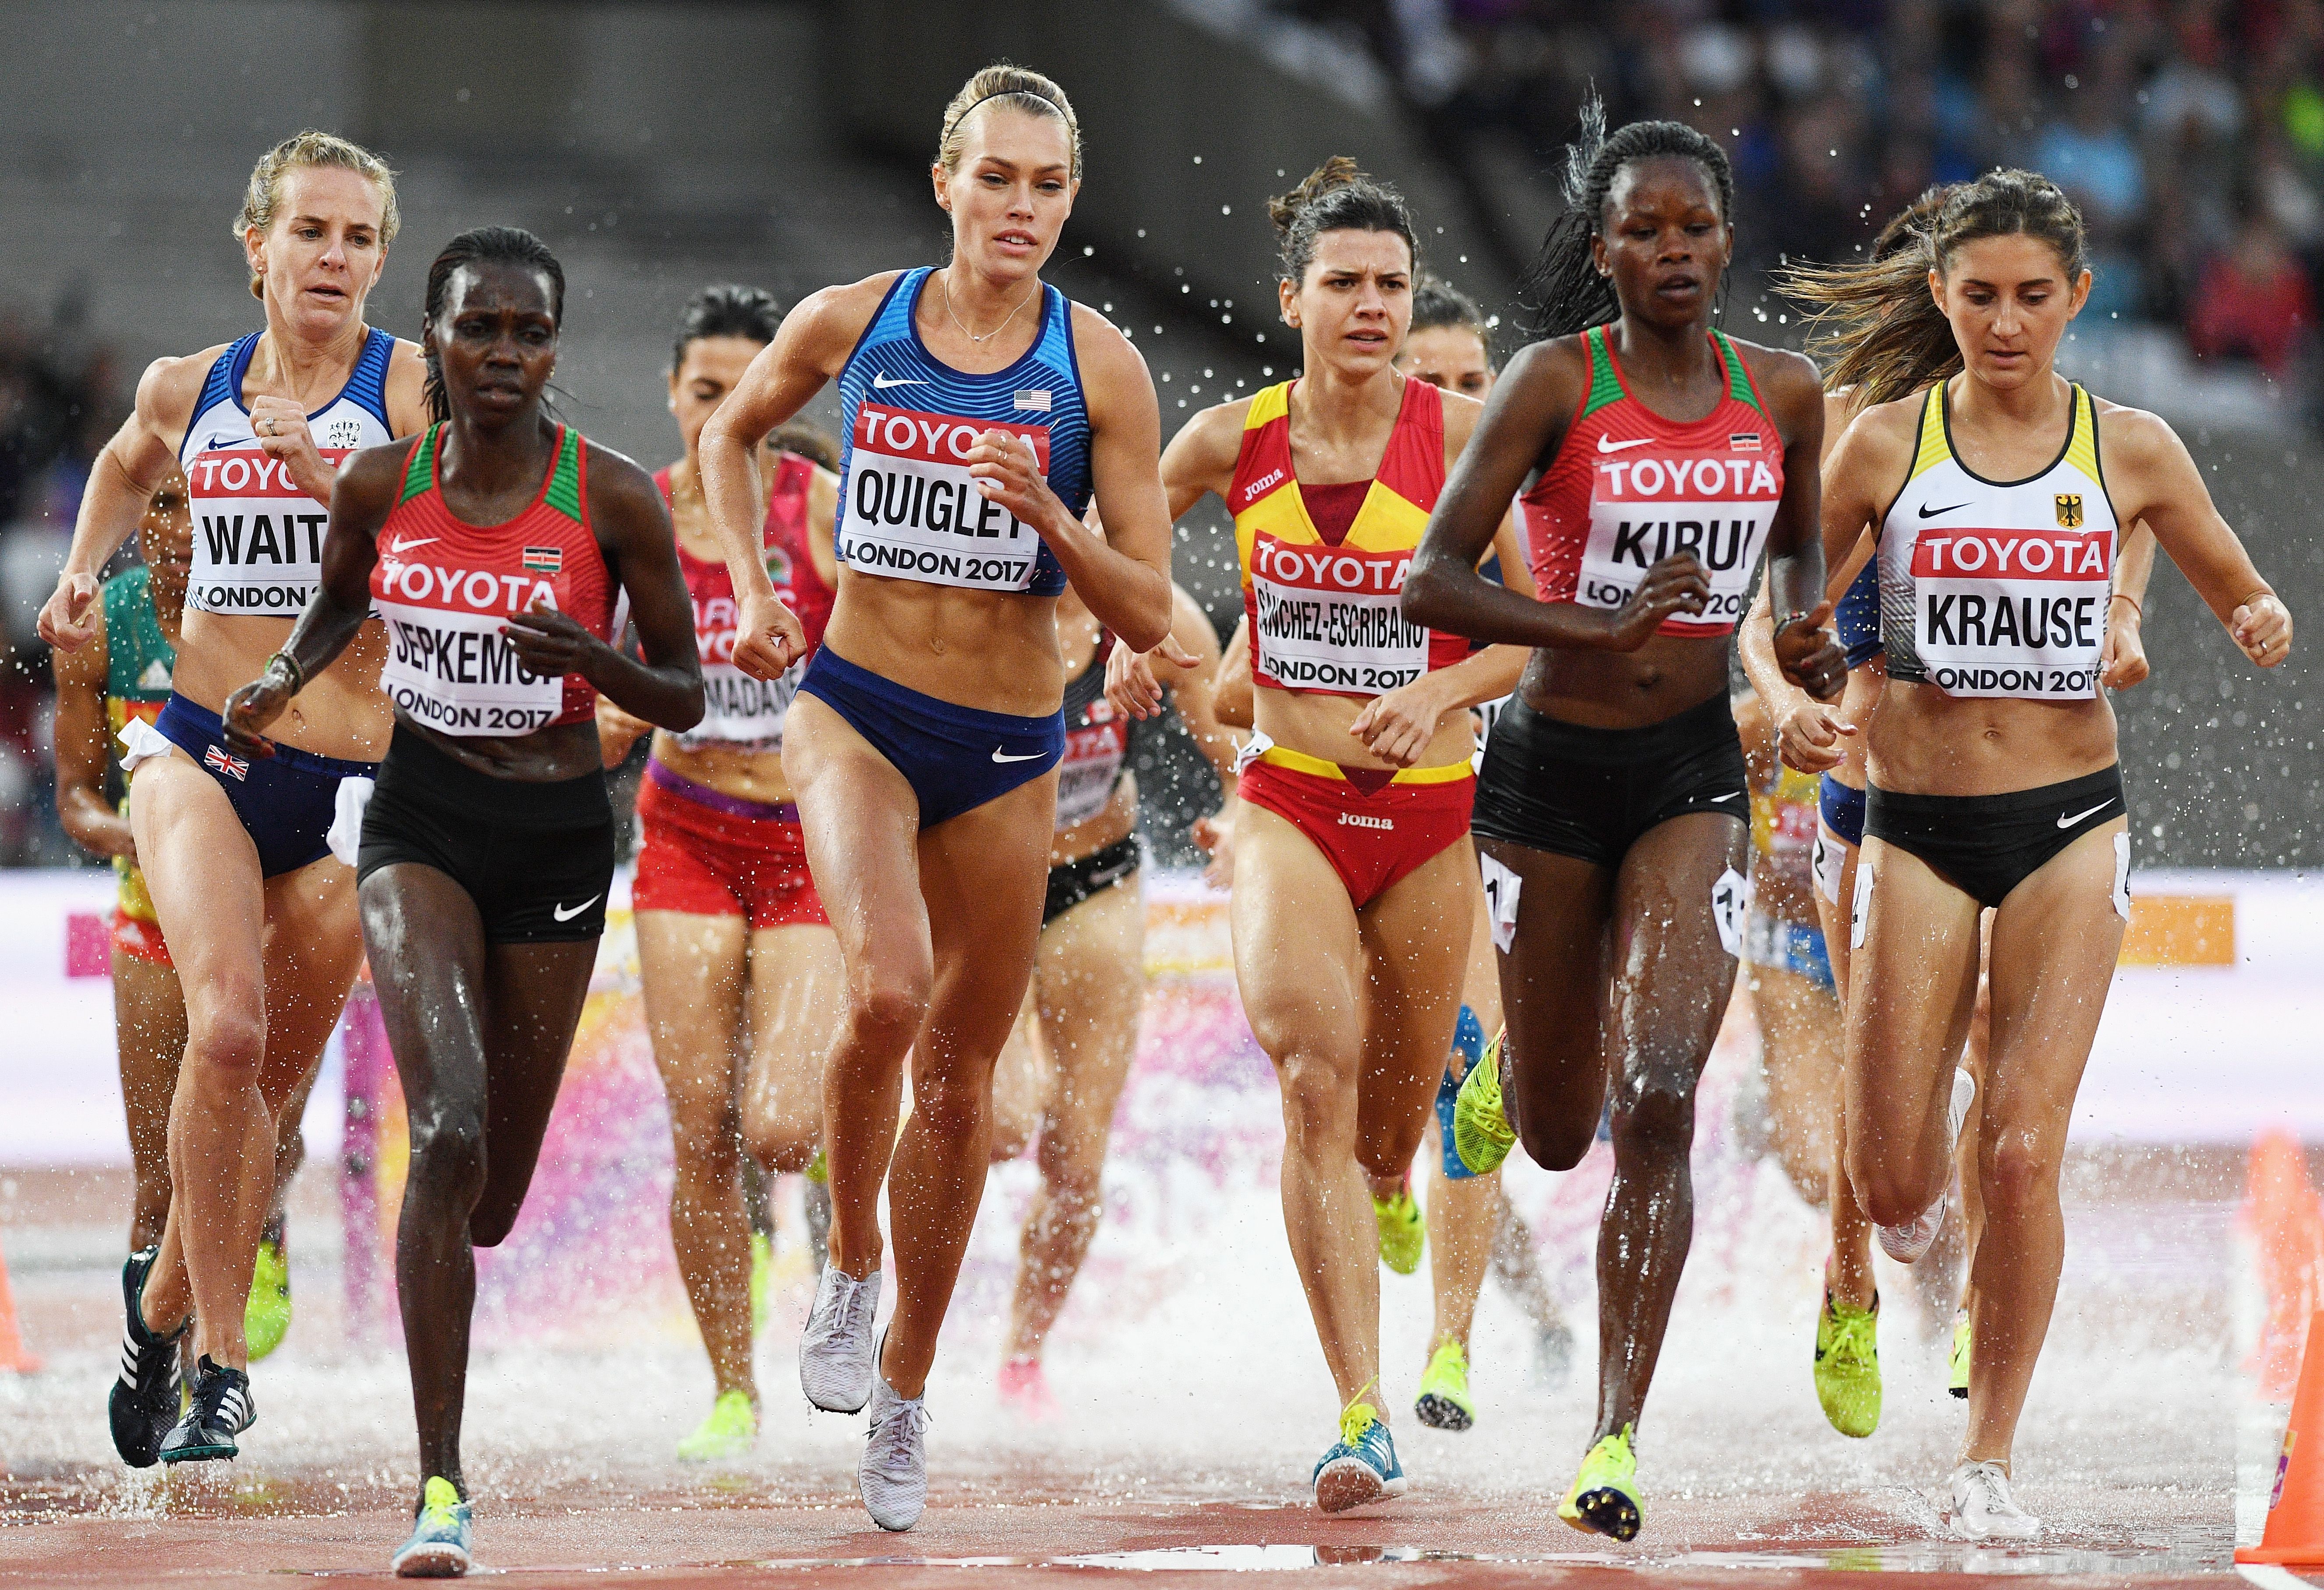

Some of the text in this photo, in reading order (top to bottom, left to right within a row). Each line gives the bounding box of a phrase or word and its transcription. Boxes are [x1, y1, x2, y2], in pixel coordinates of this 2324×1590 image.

[863, 410, 1042, 468] TOYOA
[1601, 459, 1777, 496] TOYOTA
[845, 539, 1030, 583] LONDON 2017
[1256, 539, 1412, 589] TOYOTA
[1611, 520, 1756, 571] KIRUI
[1924, 537, 2104, 574] TOYOTA
[382, 562, 559, 613] TOYOTA
[1927, 594, 2096, 649] KRAUSE
[1263, 651, 1421, 689] LONDON 2017
[488, 708, 555, 729] 2017
